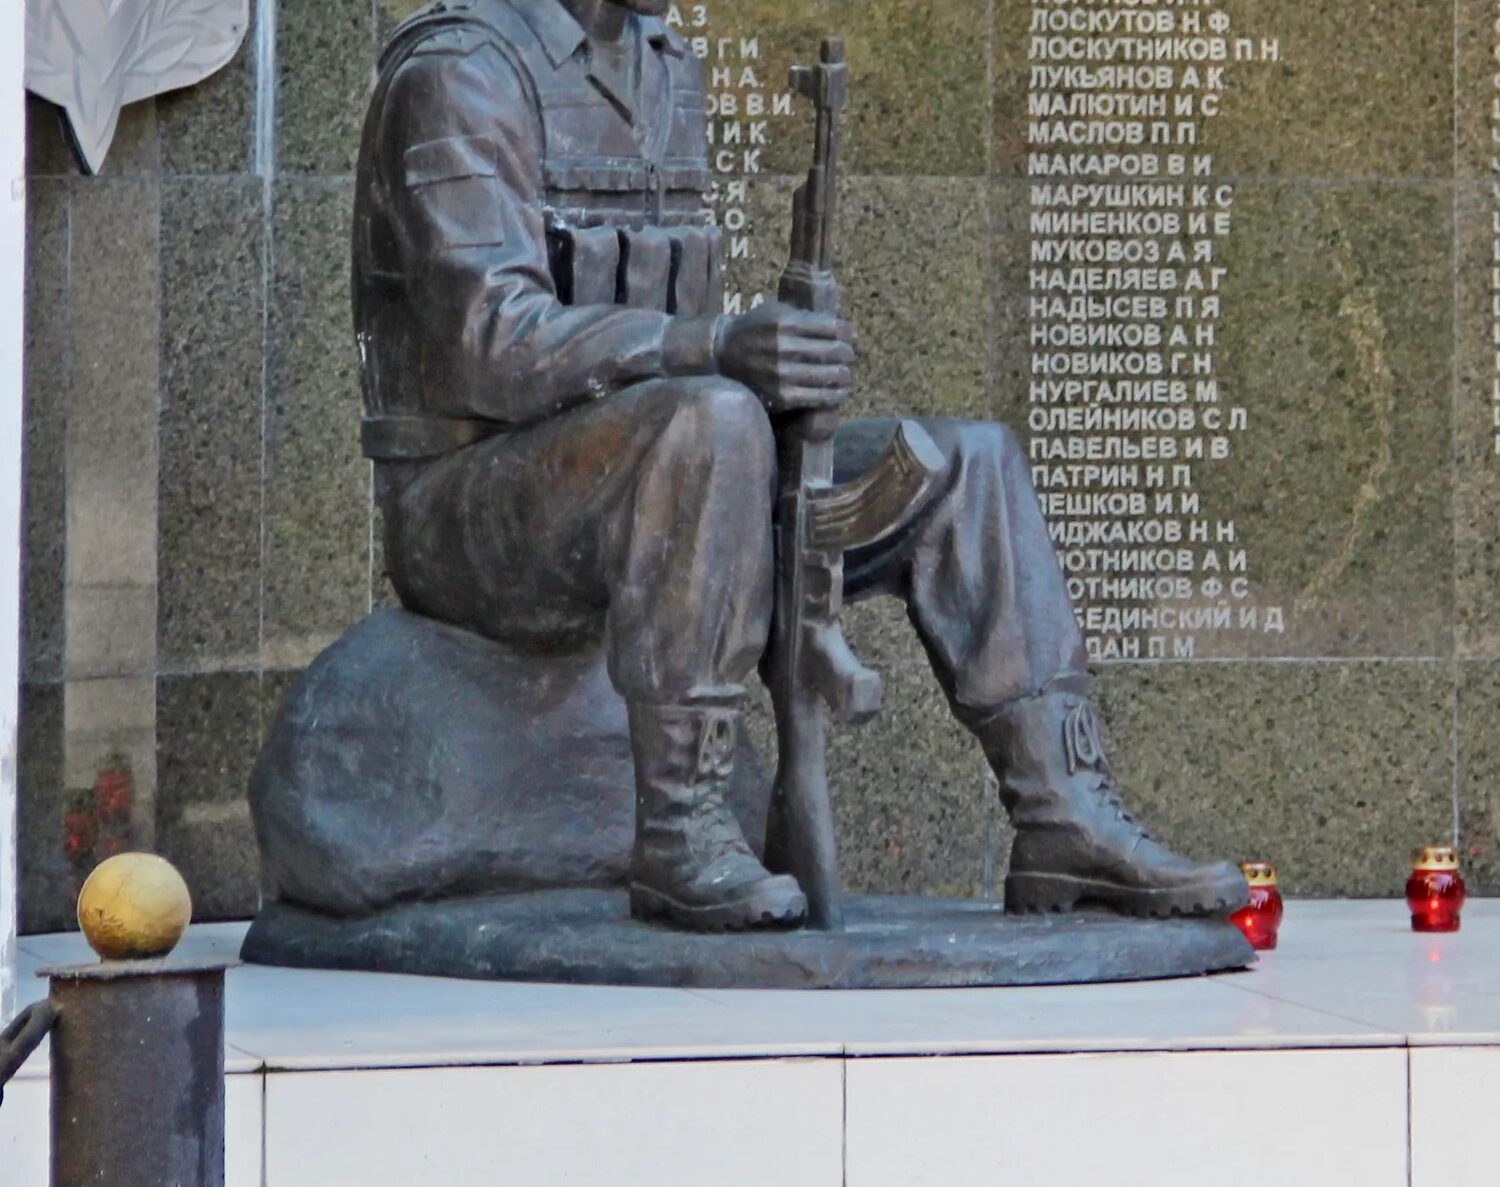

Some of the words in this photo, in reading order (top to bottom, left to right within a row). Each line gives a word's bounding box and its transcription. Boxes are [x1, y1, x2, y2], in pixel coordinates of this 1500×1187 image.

[1029, 9, 1174, 33] ЛОСКУТОВ
[1028, 37, 1226, 60] ЛОСКУТНИКОВ
[1029, 94, 1165, 116] МАЛЮТИН
[1029, 122, 1143, 143] МАСЛОВ
[1029, 154, 1158, 175] МАКАРОВ
[1031, 184, 1183, 206] МАРУШКИН
[1031, 213, 1179, 234] МИНЕНКОВ
[1032, 240, 1159, 262] МУКОВОЗ
[1029, 269, 1176, 294] НАДЕЛЯЕВ
[1031, 325, 1160, 346] НОВИКОВ
[1032, 353, 1162, 374] НОВИКОВ
[1030, 381, 1186, 402] НУРГАЛИЕВ
[1029, 403, 1194, 430] ОЛЕЙНИКОВ
[1030, 437, 1176, 459] ПАВЕЛЬЕВ
